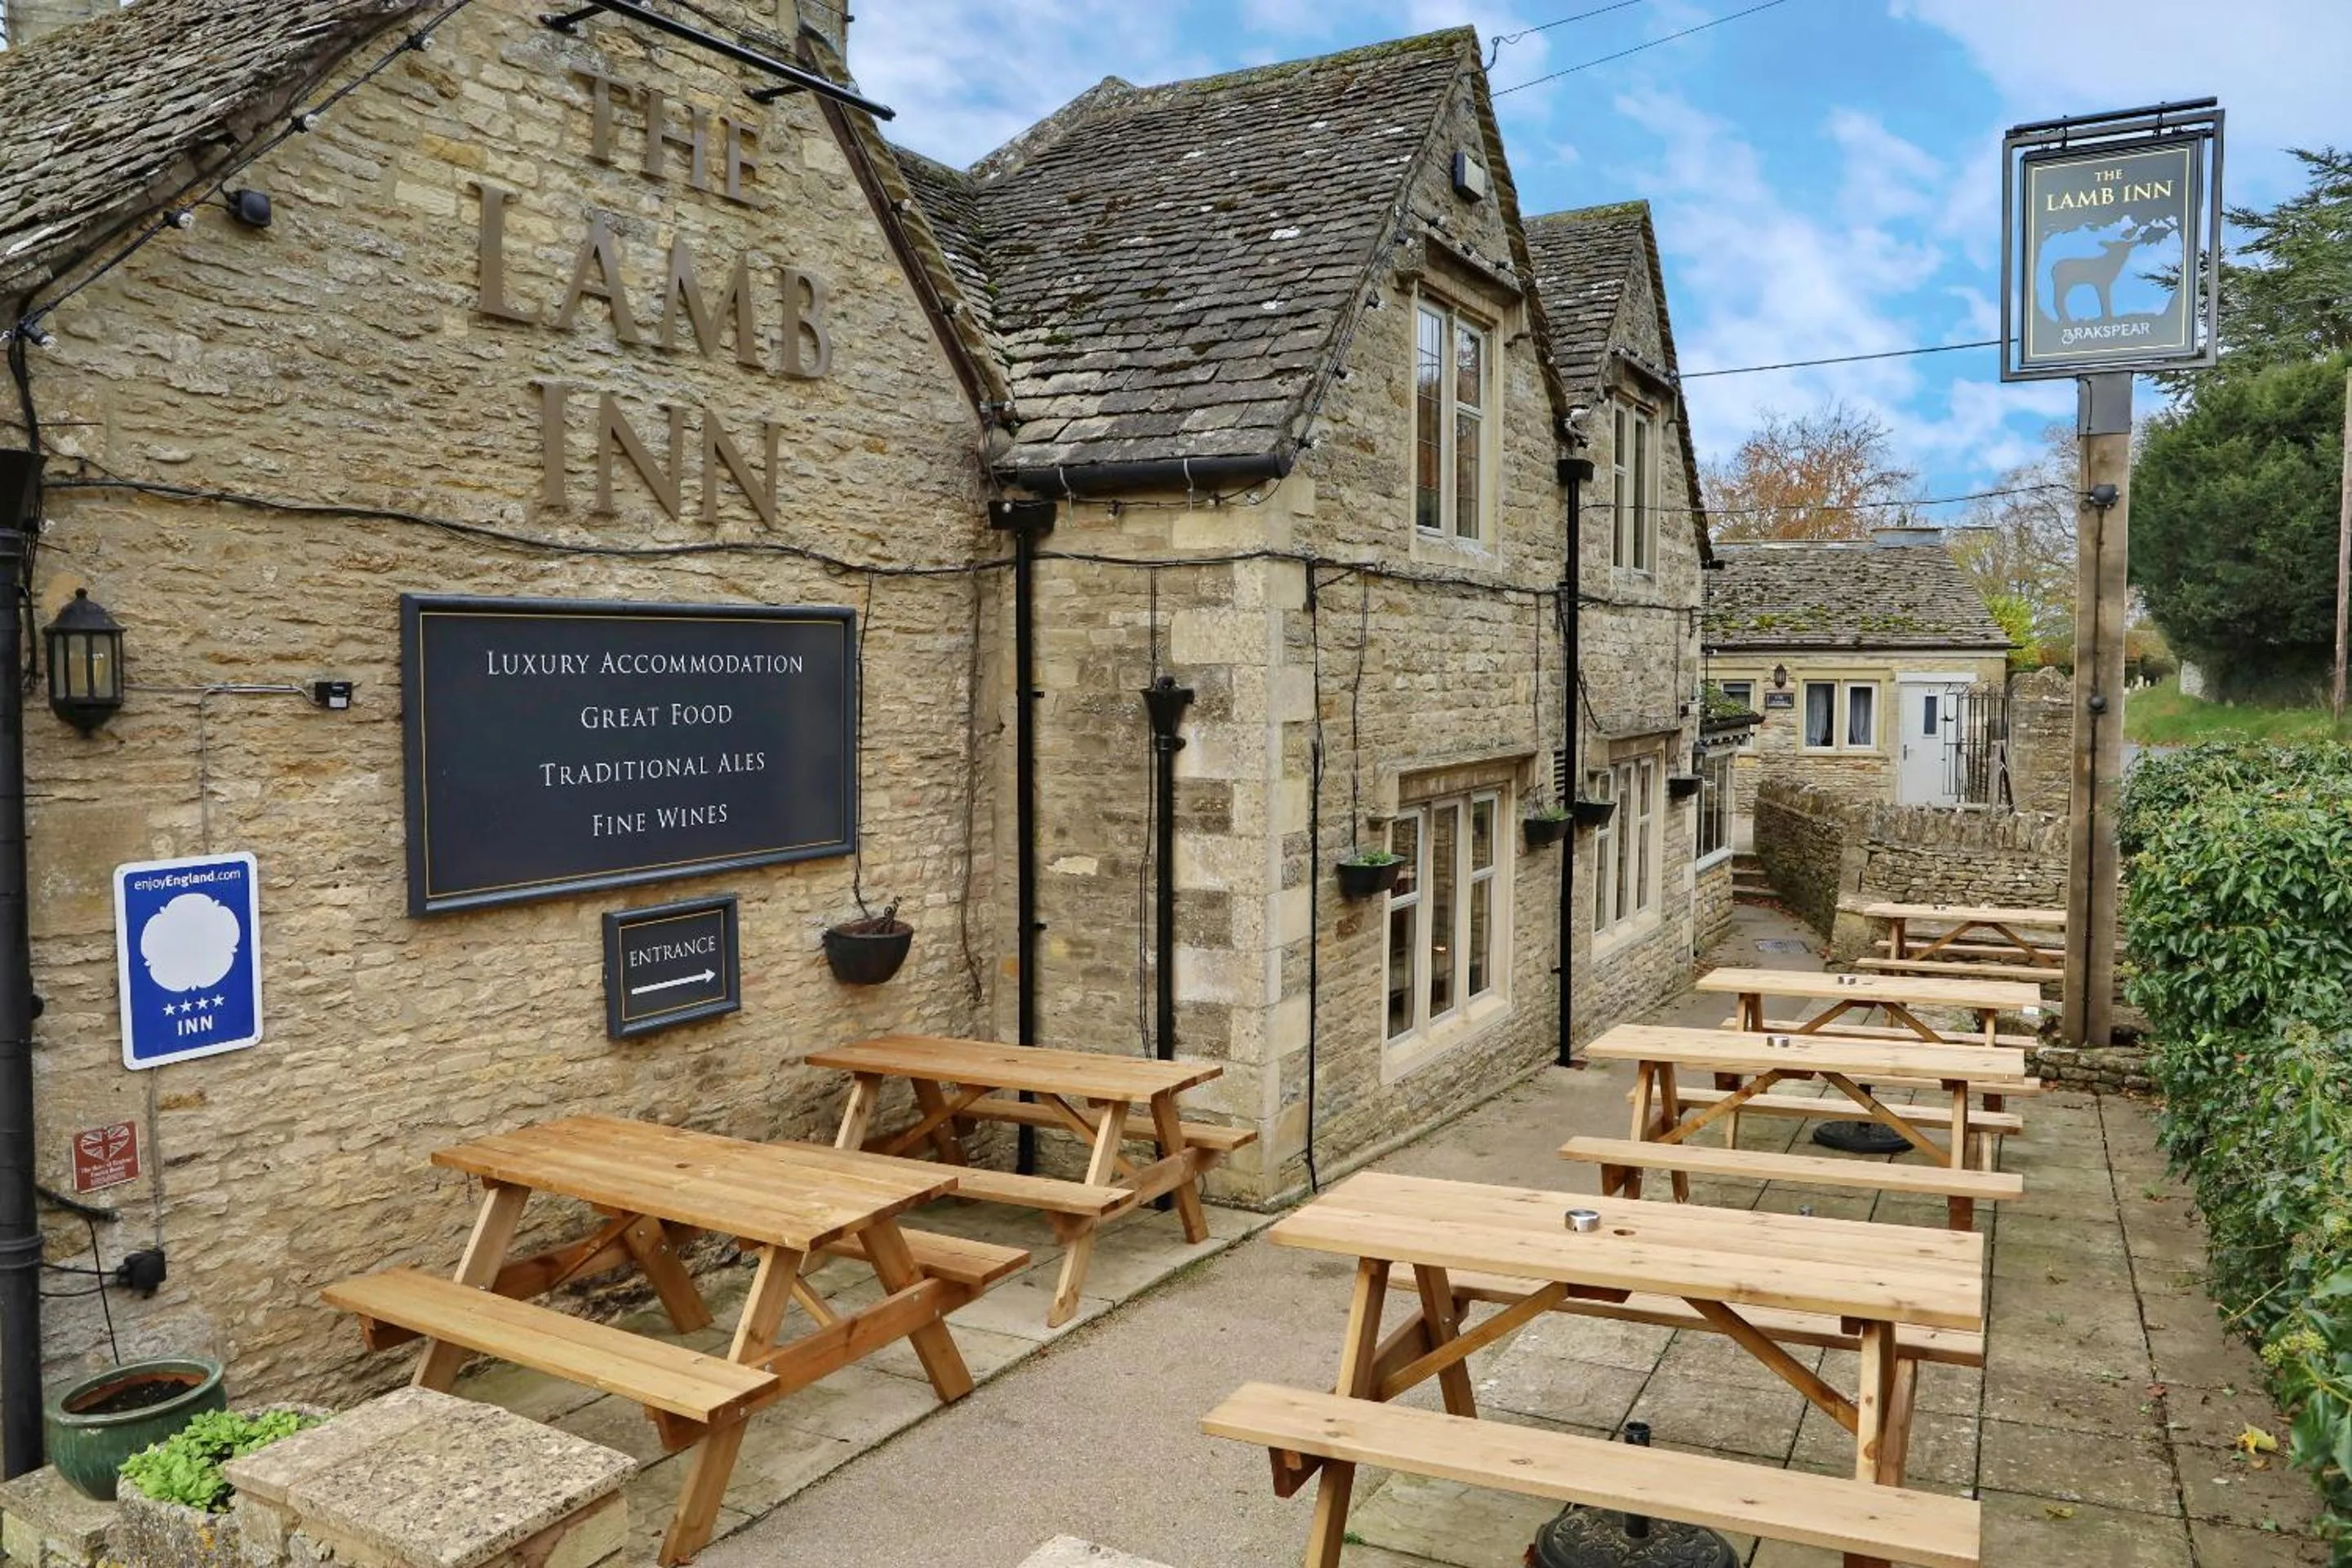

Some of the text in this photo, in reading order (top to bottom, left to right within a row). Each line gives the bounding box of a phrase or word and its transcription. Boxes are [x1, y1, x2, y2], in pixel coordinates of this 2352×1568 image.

[569, 69, 761, 207] THE
[2094, 169, 2123, 181] THE
[2047, 180, 2173, 211] LAMB INN
[469, 182, 833, 379] LAMB
[2061, 322, 2150, 345] BRAKSPEAR
[529, 380, 784, 531] INN
[487, 651, 803, 675] LUXURY ACCOMMODATION
[580, 704, 732, 729] GREAT FOOD
[540, 752, 765, 787] TRADITIONAL ALES
[593, 803, 727, 836] FINE WINES
[134, 868, 241, 891] enjoyEngland.com
[629, 935, 716, 967] ENTRANCE
[177, 1015, 213, 1036] INN
